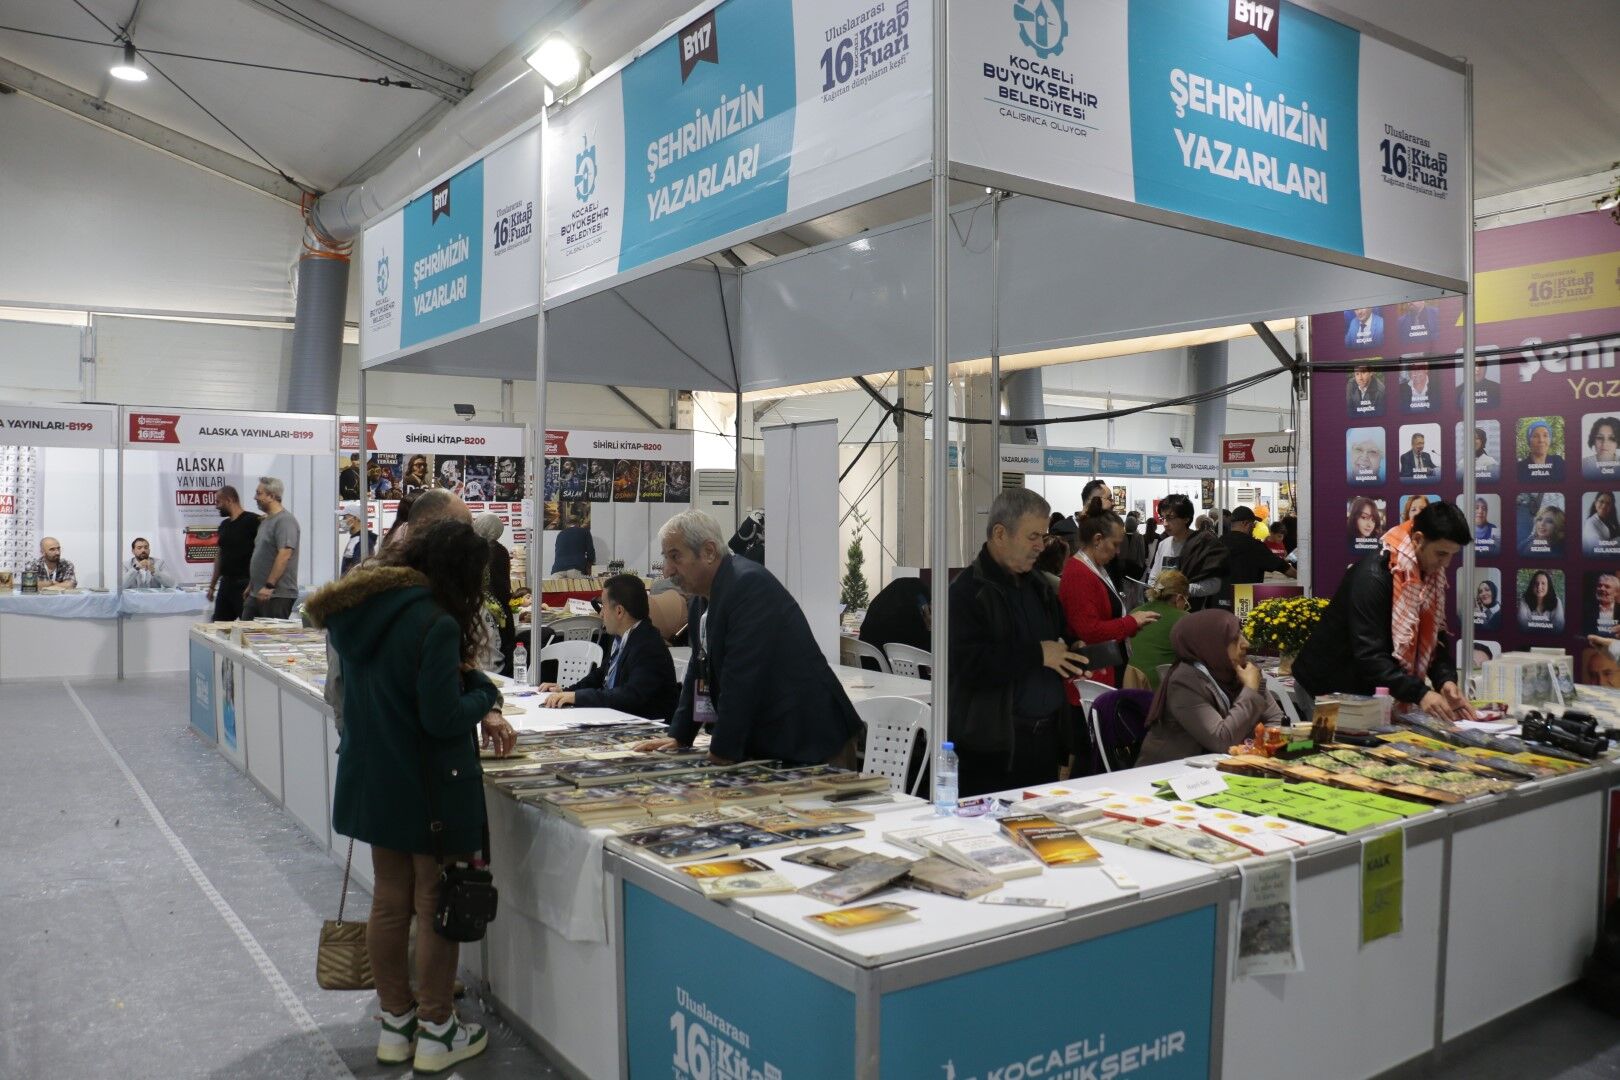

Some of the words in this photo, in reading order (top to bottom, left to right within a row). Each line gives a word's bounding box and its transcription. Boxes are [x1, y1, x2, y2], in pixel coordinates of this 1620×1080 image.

[825, 3, 885, 42] Uluslararası
[1234, 0, 1274, 31] B117
[684, 22, 712, 61] B117
[860, 11, 909, 51] Kitap
[860, 33, 909, 73] Fuarı
[1010, 55, 1074, 85] KOCAELİ
[984, 63, 1098, 109] BÜYÜKŞEHİR
[999, 86, 1086, 120] BELEDİYESİ
[1170, 68, 1328, 150] ŞEHRİMİZİN
[647, 84, 764, 184] ŞEHRİMİZİN
[1050, 121, 1087, 138] OLUYOR
[1384, 123, 1431, 148] Uluslararası
[1174, 128, 1328, 204] YAZARLARI
[1411, 148, 1448, 177] Kitap
[647, 144, 760, 223] YAZARLARI
[1411, 165, 1448, 191] Fuarı
[434, 189, 449, 211] B117
[571, 200, 599, 220] KOCAELİ
[511, 209, 533, 228] Kitap
[511, 223, 532, 242] Fuarı
[561, 206, 609, 236] BÜYÜKŞEHİR
[567, 222, 602, 245] BELEDİYESİ
[414, 234, 469, 289] ŞEHRİMİZİN
[414, 275, 468, 317] YAZARLARI
[7, 419, 93, 431] YAYINLARI-B199
[198, 427, 239, 437] ALASKA
[241, 429, 314, 439] YAYINLARI-B199
[405, 433, 436, 443] SİHİRLİ
[437, 435, 486, 445] KİTAP-B200
[593, 440, 619, 450] SİHİRLİ
[620, 441, 662, 451] KİTAP-B200
[176, 457, 225, 472] ALASKA
[177, 476, 226, 487] YAYINLARI
[177, 491, 201, 504] İMZA
[677, 986, 750, 1049] Uluslararası
[988, 1033, 1105, 1080] KOCAELİ
